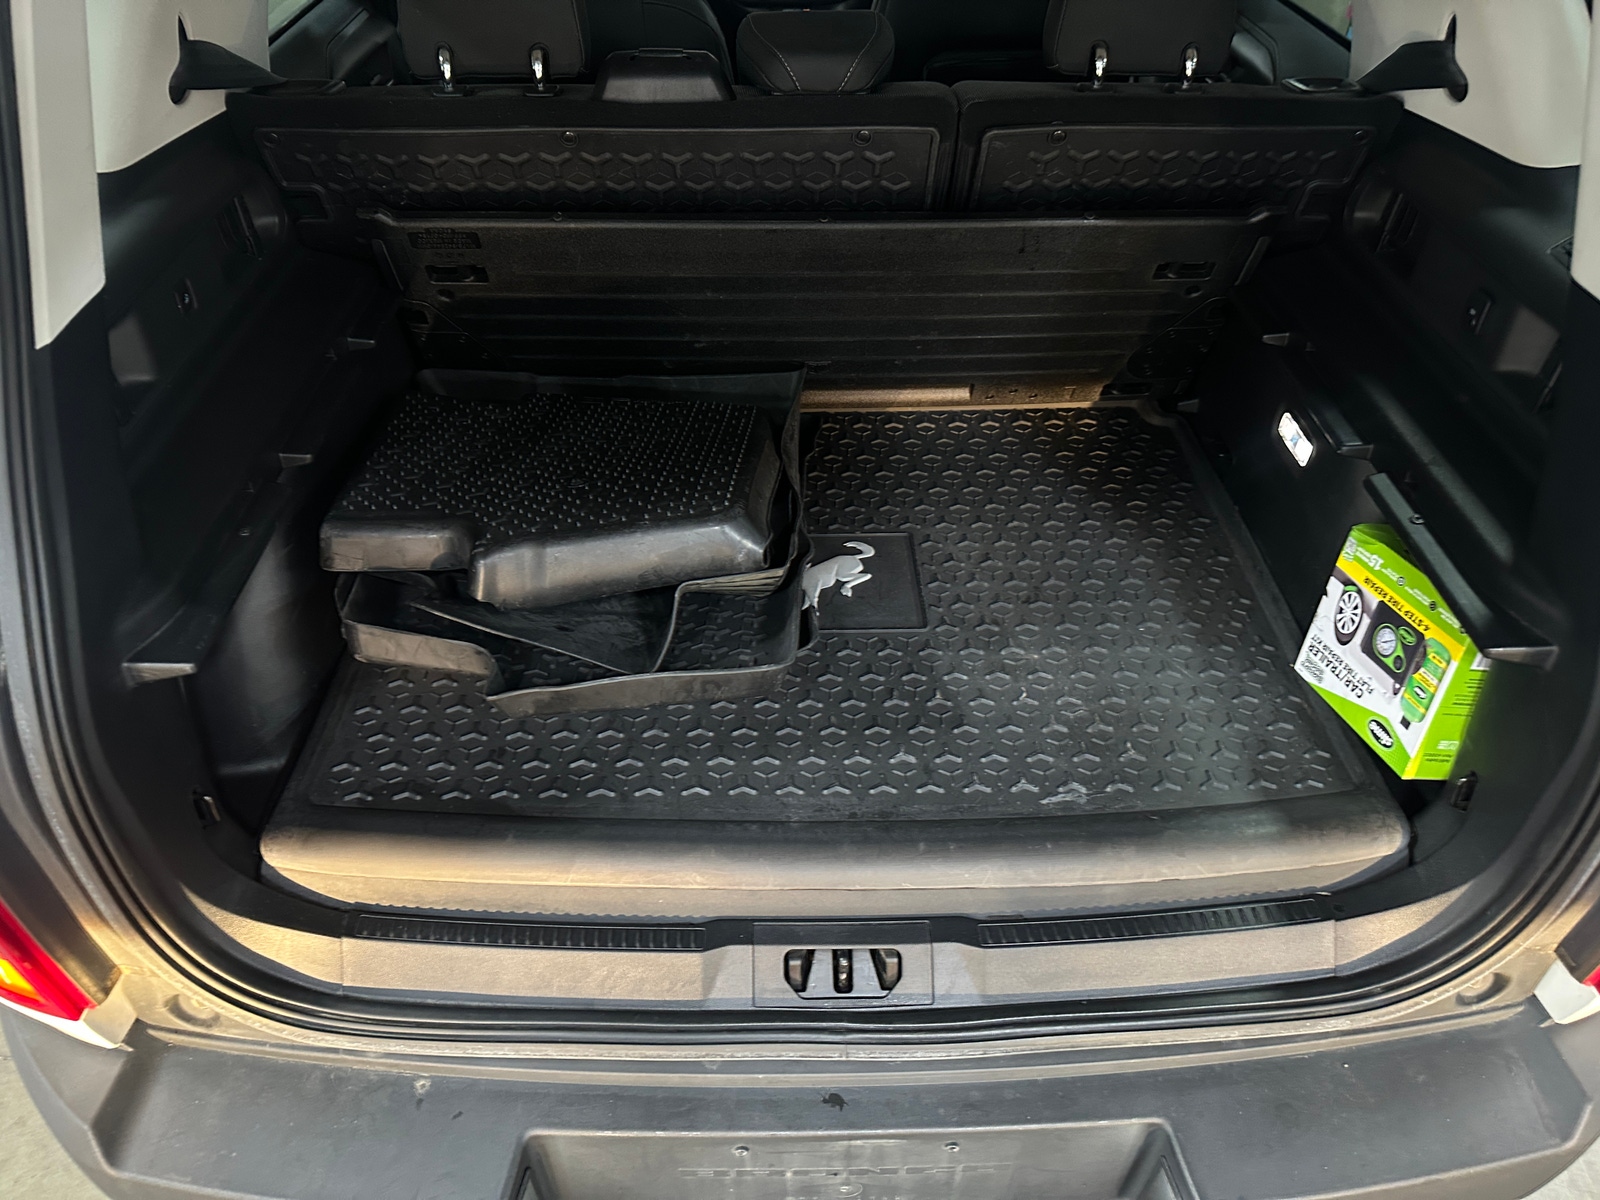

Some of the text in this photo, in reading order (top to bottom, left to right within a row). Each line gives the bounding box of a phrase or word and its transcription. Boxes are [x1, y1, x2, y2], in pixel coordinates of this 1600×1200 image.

[1366, 553, 1384, 571] 15
[1363, 576, 1389, 598] REPAIR
[1387, 595, 1404, 612] TIRE
[1402, 609, 1431, 633] 4-STEP
[1310, 633, 1323, 646] KIT
[1321, 642, 1344, 666] REPAIR
[1307, 641, 1365, 699] CAR/TRAILER
[1341, 662, 1357, 679] TIRE
[1355, 676, 1375, 694] FLAT
